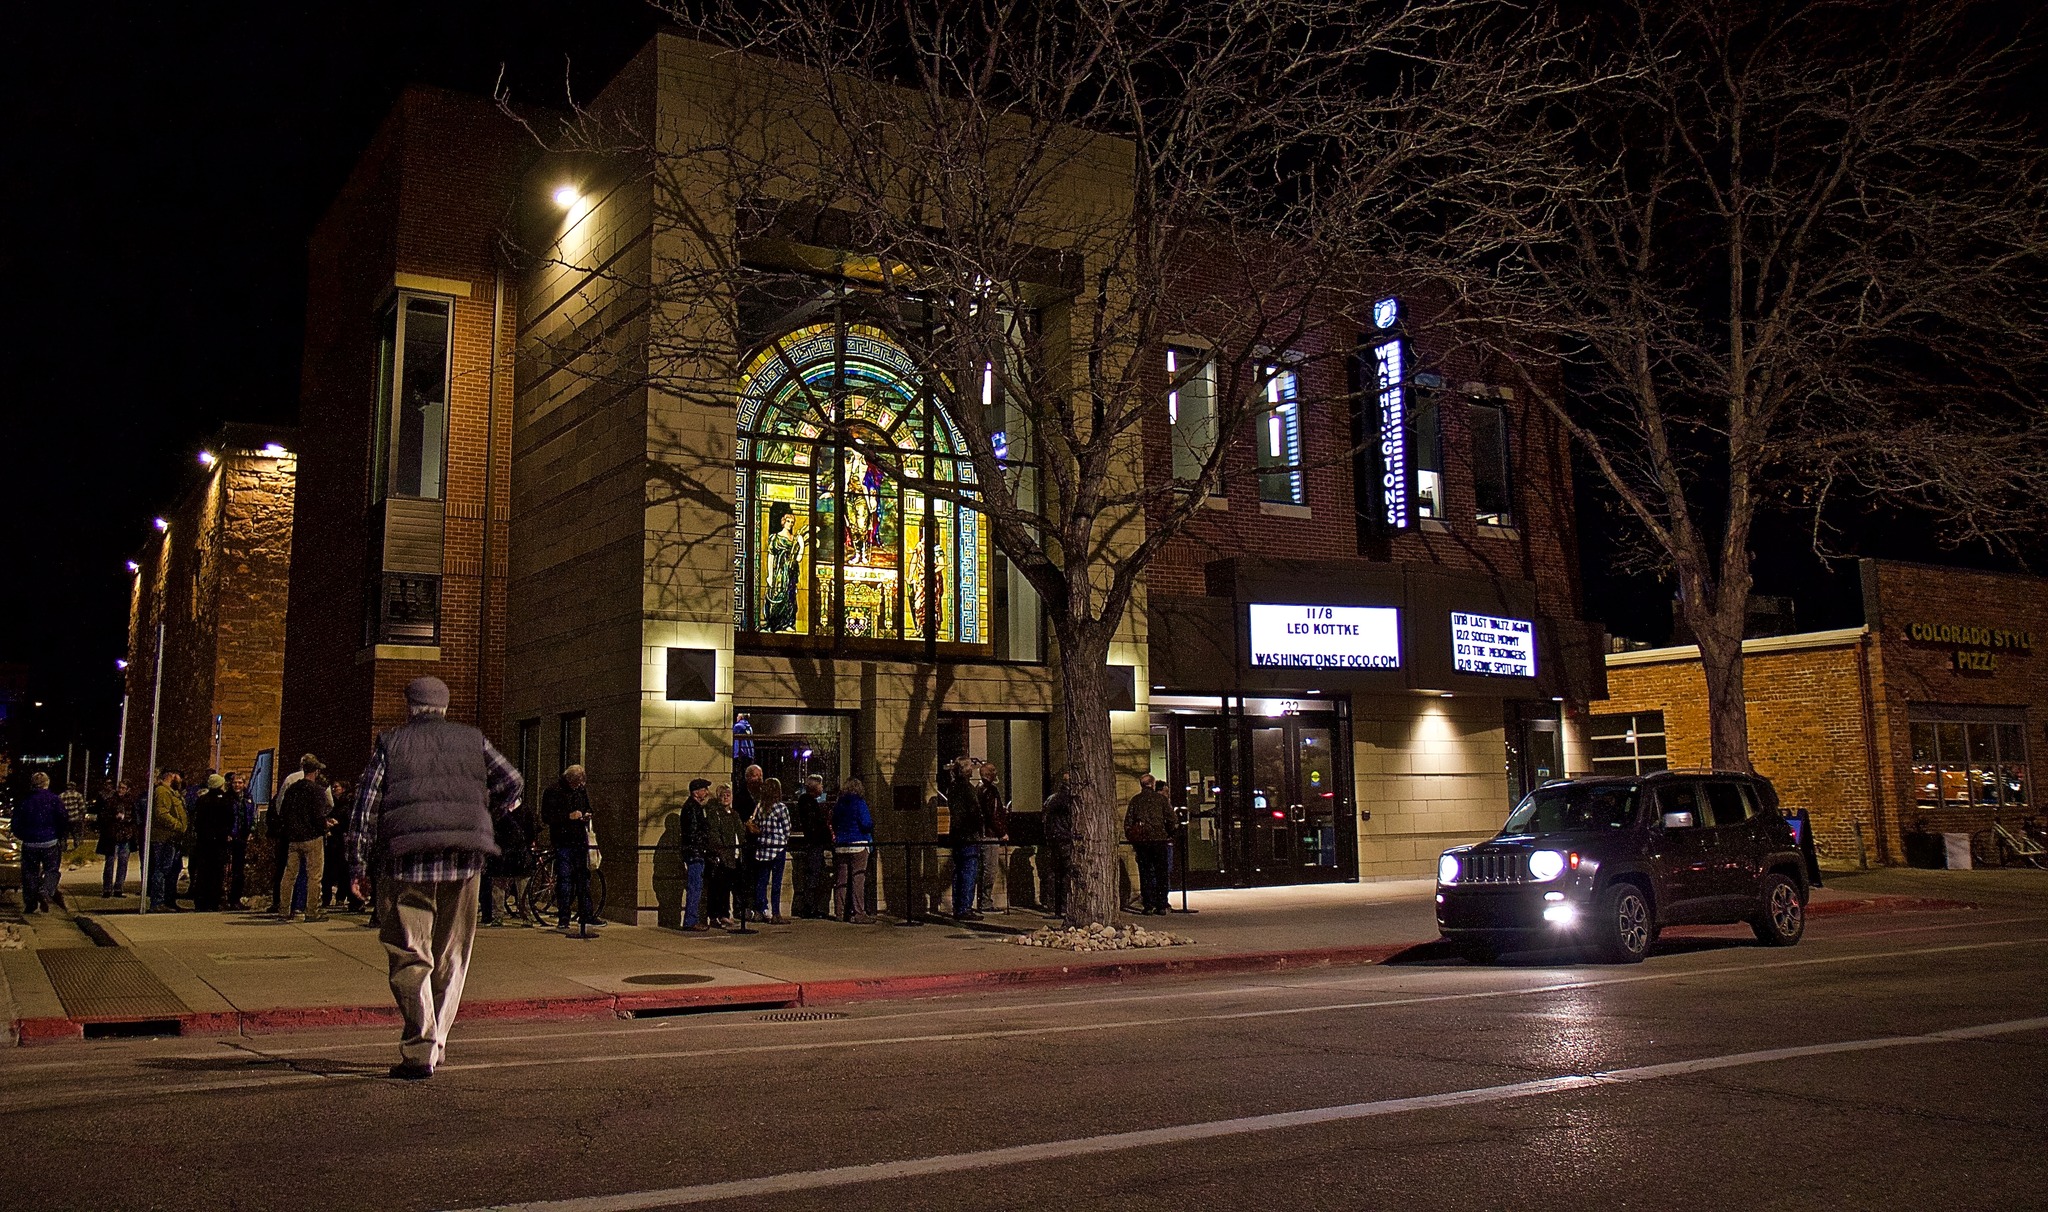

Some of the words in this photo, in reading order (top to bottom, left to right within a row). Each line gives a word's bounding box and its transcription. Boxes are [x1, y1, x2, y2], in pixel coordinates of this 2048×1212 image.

[1307, 607, 1333, 619] 11/8
[1470, 616, 1487, 628] LAST
[1287, 623, 1309, 634] LEO
[1313, 623, 1360, 636] KOTTKE
[1910, 622, 1991, 647] COLORADO
[1472, 645, 1486, 656] THE
[1255, 652, 1397, 668] WASHINGTONSFOCO.COM
[1957, 650, 1999, 670] PIZZA
